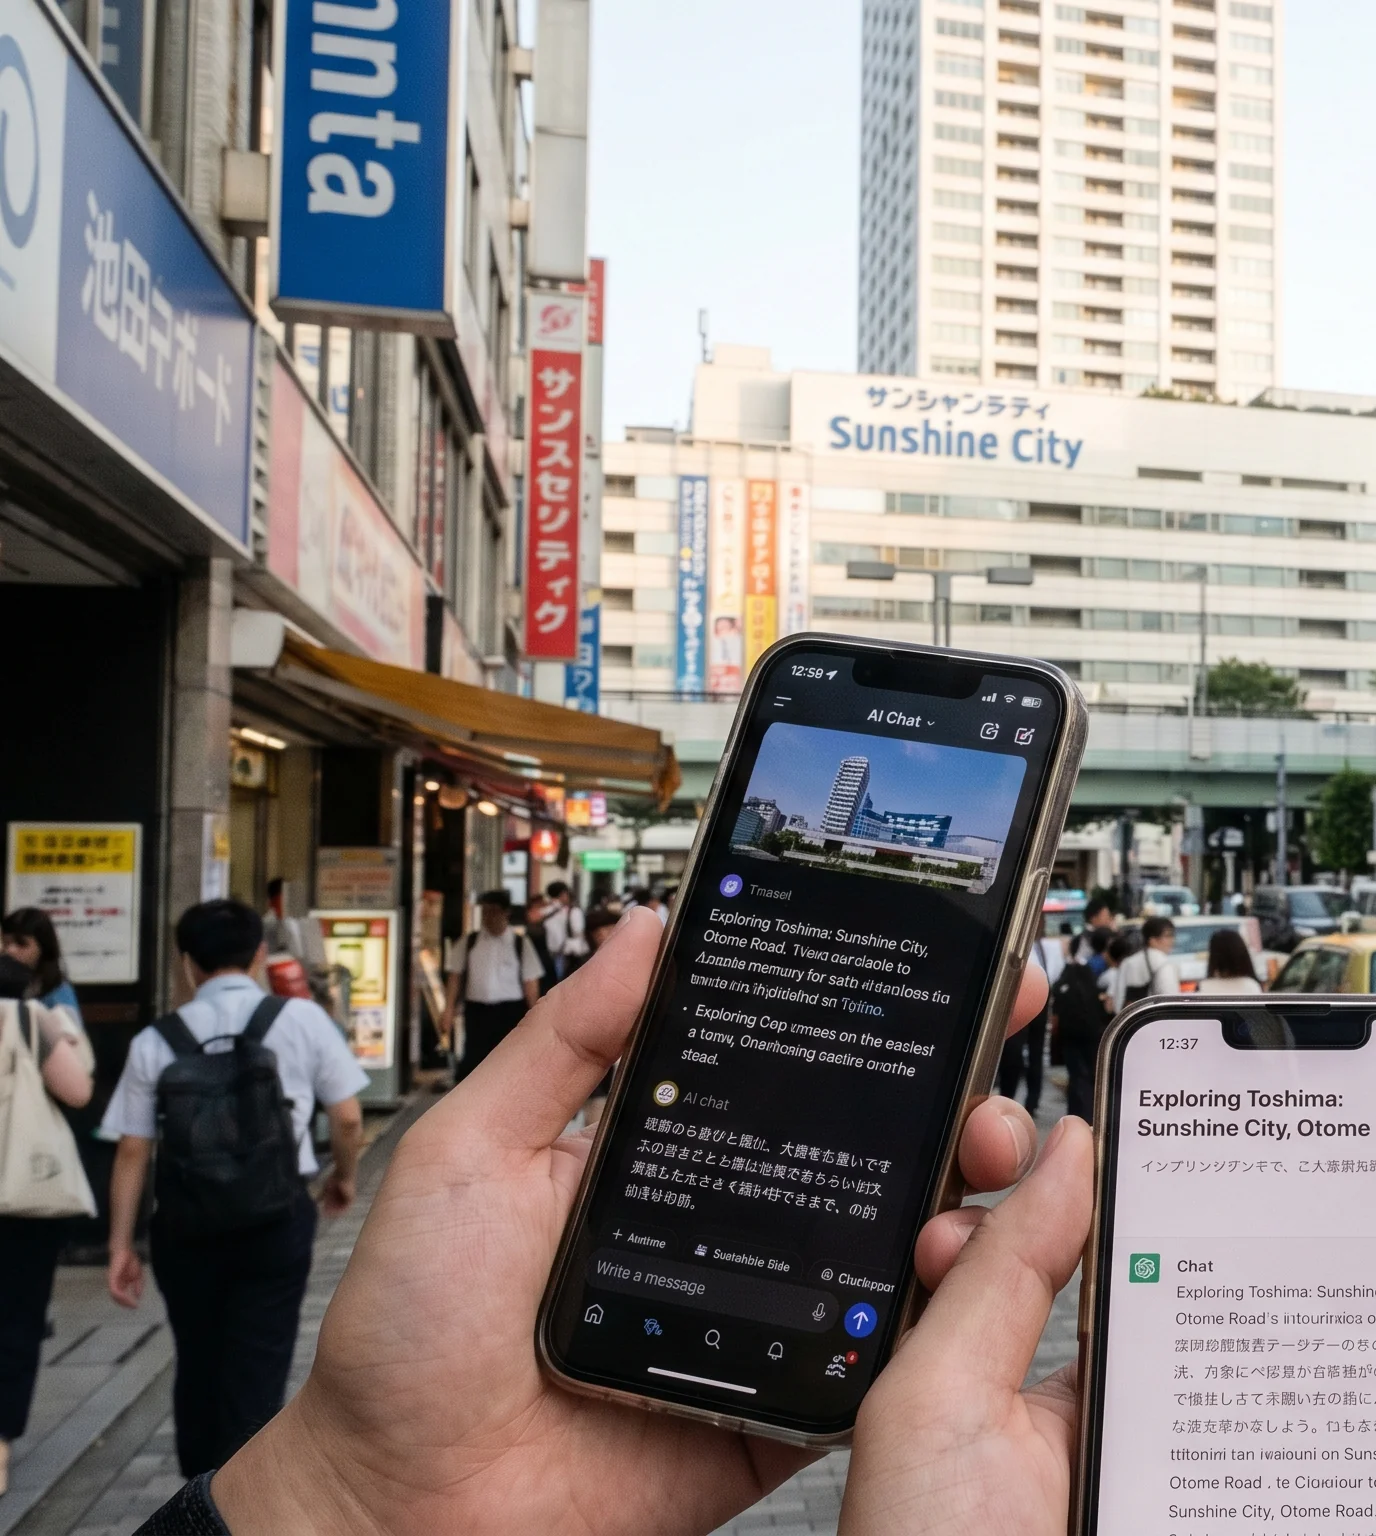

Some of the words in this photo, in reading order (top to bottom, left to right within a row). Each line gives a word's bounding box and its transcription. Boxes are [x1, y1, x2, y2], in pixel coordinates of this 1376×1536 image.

[828, 415, 1000, 460] Sunshine
[1011, 426, 1084, 470] City
[867, 708, 886, 724] AI
[886, 711, 922, 729] Chat
[709, 908, 772, 933] Exploring
[775, 918, 833, 941] Toshima:
[834, 928, 898, 951] Sunshine
[900, 939, 929, 959] City,
[703, 929, 748, 948] Otome
[749, 937, 788, 956] Road.
[896, 961, 911, 975] to
[806, 968, 828, 985] for
[687, 1027, 697, 1039] a
[695, 1003, 758, 1030] Exploring
[838, 1031, 857, 1045] on
[860, 1032, 883, 1049] the
[1159, 1038, 1199, 1050] 12:37
[683, 1091, 699, 1105] AI
[699, 1094, 731, 1111] chat
[1139, 1089, 1241, 1112] Exploring
[1246, 1089, 1343, 1108] Toshima:
[1137, 1118, 1239, 1138] Sunshine
[1244, 1118, 1291, 1141] City,
[1297, 1118, 1371, 1138] Otome
[1177, 1259, 1214, 1273] Chat
[597, 1260, 631, 1281] Write
[632, 1271, 643, 1283] a
[644, 1273, 706, 1297] message
[1177, 1285, 1244, 1302] Exploring
[1248, 1285, 1312, 1299] Toshima:
[1175, 1312, 1225, 1326] Otome
[1229, 1311, 1279, 1325] Road's
[1231, 1448, 1255, 1461] tan
[1321, 1450, 1340, 1461] on
[1169, 1475, 1220, 1490] Otome
[1224, 1475, 1262, 1490] Road
[1276, 1476, 1290, 1490] te
[1168, 1504, 1237, 1519] Sunshine
[1242, 1504, 1275, 1522] City,
[1280, 1504, 1331, 1519] Otome
